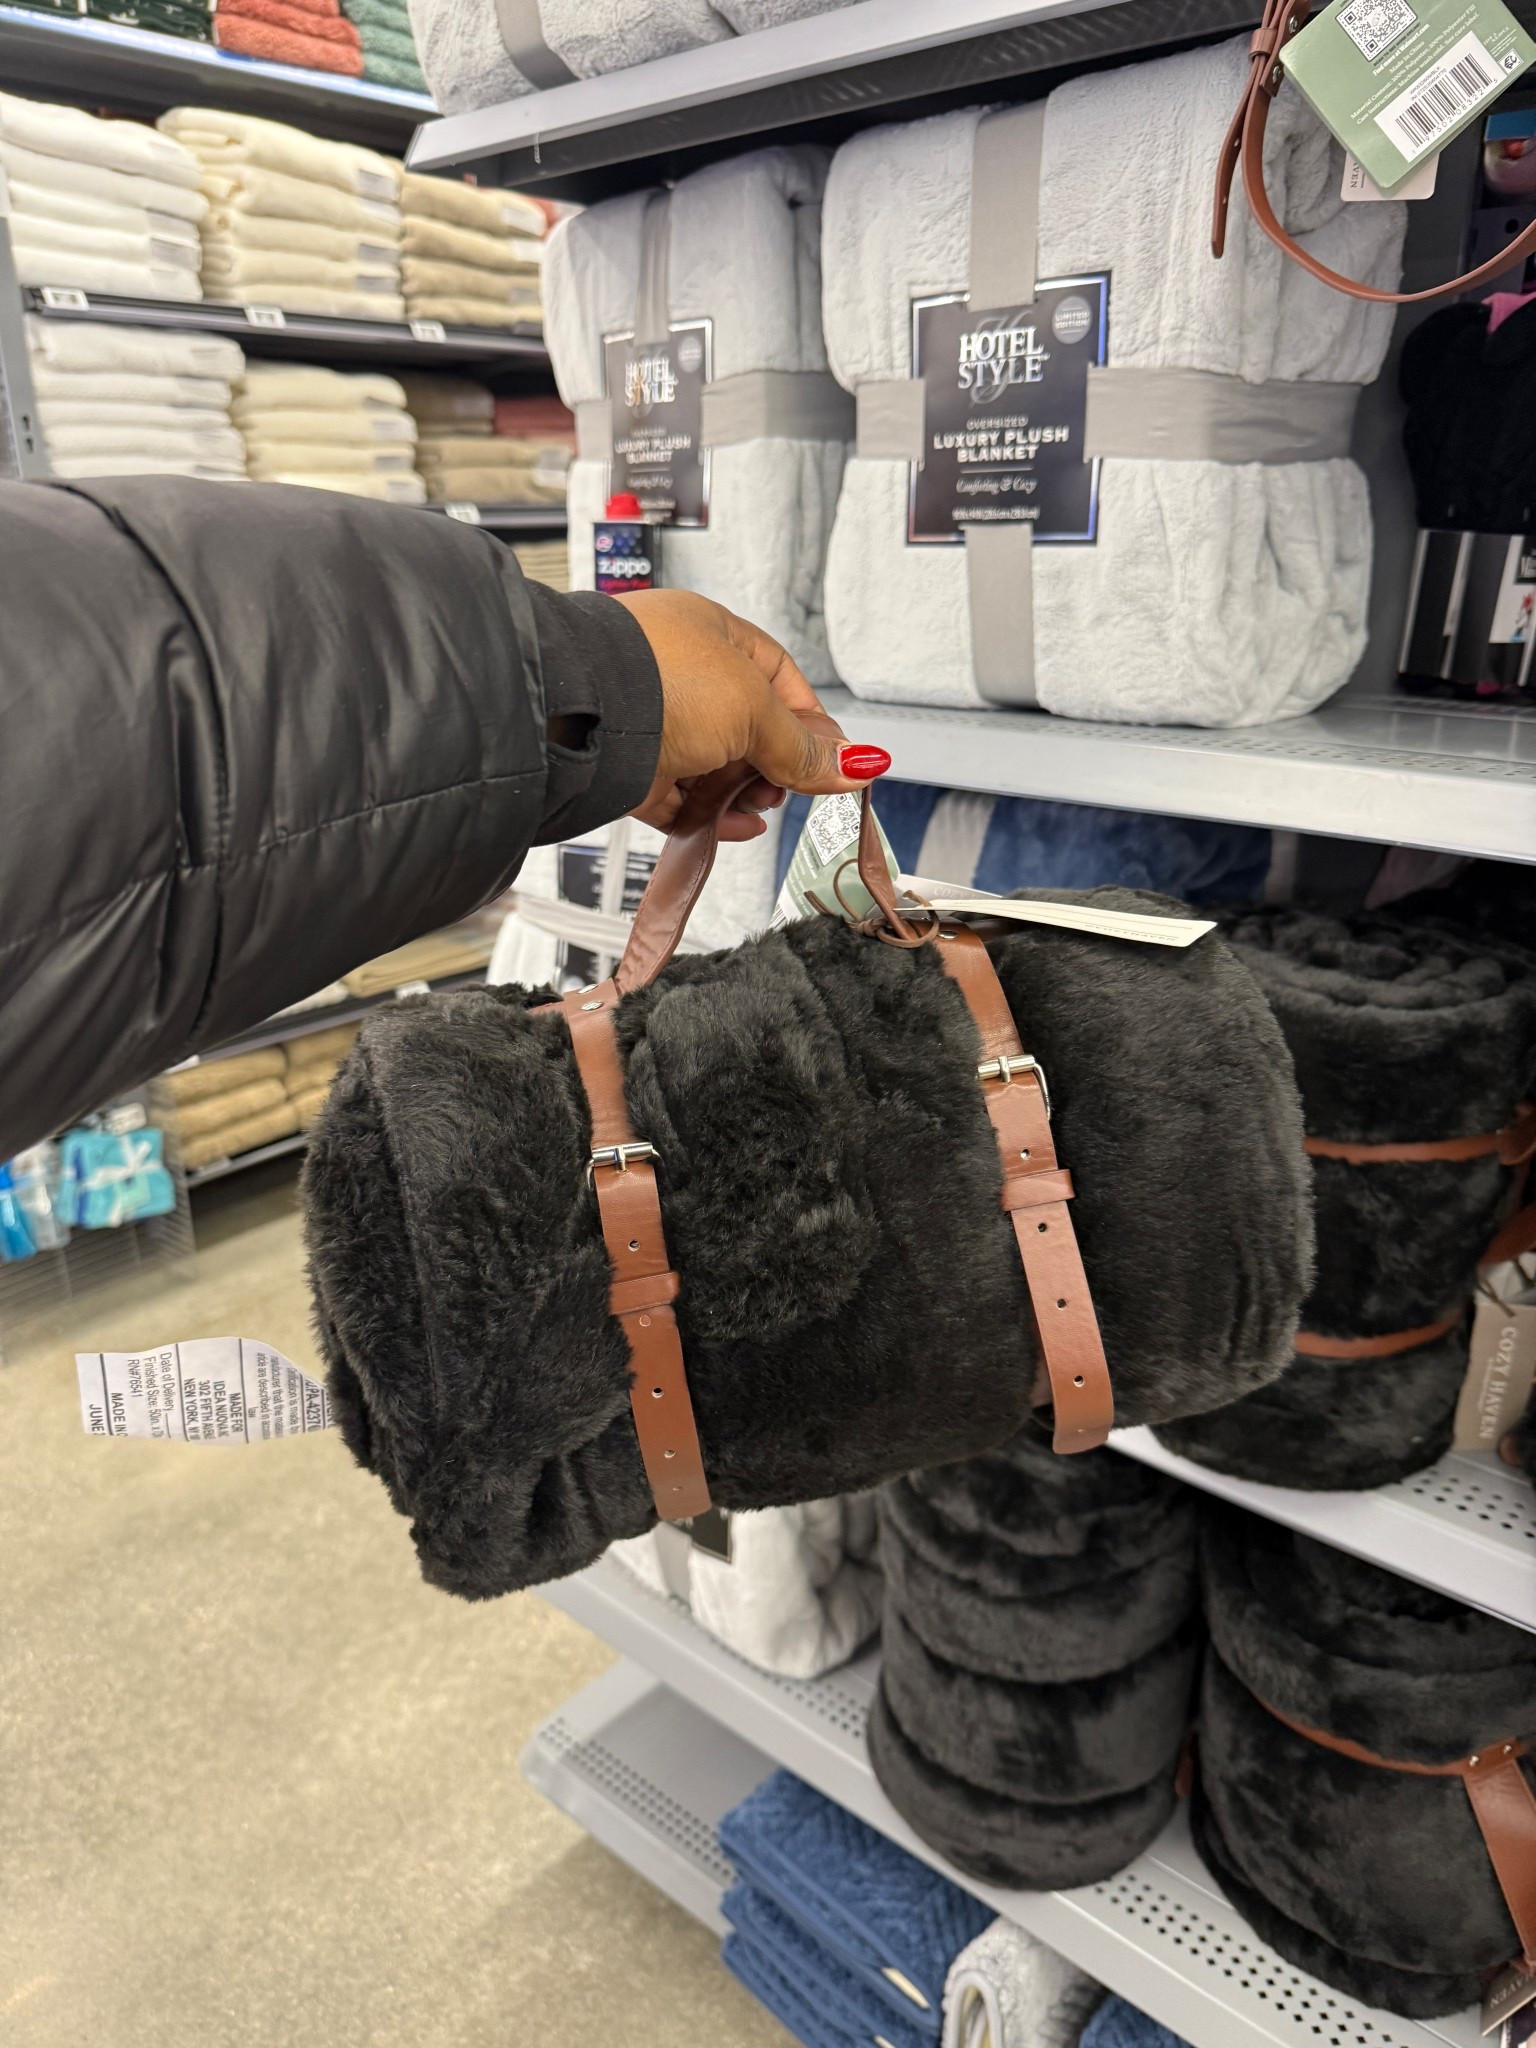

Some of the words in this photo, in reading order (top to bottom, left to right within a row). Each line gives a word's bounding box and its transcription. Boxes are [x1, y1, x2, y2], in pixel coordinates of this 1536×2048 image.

[1349, 98, 1372, 119] Material
[1370, 80, 1393, 101] Content:
[1391, 67, 1407, 82] 100%
[1428, 33, 1444, 49] 100%
[1442, 12, 1468, 36] Polyester
[1465, 3, 1476, 14] Fill
[1372, 64, 1384, 76] Find
[1382, 54, 1395, 67] more
[1398, 23, 1430, 52] Walmart.com
[1388, 58, 1404, 73] Made
[1402, 53, 1410, 61] in
[1408, 39, 1425, 56] China
[1356, 112, 1369, 124] Care
[1397, 67, 1419, 87] Machine
[1416, 54, 1433, 69] wash
[1443, 33, 1455, 45] See
[1453, 24, 1466, 36] care
[1424, 115, 1454, 142] 97502
[1454, 88, 1484, 115] 08322
[959, 328, 1044, 360] HOTEL
[626, 358, 675, 385] HOTEL
[958, 357, 1044, 389] STYLE
[624, 385, 675, 407] STYLE
[967, 417, 1028, 430] OVERSIZED
[933, 430, 1000, 450] LUXURY
[1005, 426, 1069, 446] PLUSH
[957, 445, 1039, 463] BLANKET
[598, 557, 651, 578] zippo
[159, 1352, 173, 1373] Date
[1495, 1327, 1517, 1375] COZY
[127, 1358, 142, 1397] RN#76541
[143, 1356, 158, 1389] Finished
[162, 1373, 174, 1382] of
[258, 1368, 266, 1378] are
[146, 1389, 160, 1408] Size:
[160, 1382, 177, 1411] Delivery
[182, 1378, 196, 1398] NEW
[198, 1379, 211, 1396] 302
[213, 1381, 226, 1403] IDEA
[259, 1379, 272, 1413] described
[273, 1388, 283, 1404] that
[88, 1403, 104, 1431] JUNE
[110, 1392, 125, 1422] MADE
[148, 1408, 162, 1425] 50in.
[183, 1399, 199, 1425] YORK,
[199, 1397, 213, 1421] FIFTH
[214, 1404, 229, 1431] NUOVA
[228, 1392, 242, 1418] MADE
[274, 1404, 283, 1417] the
[1479, 1380, 1507, 1439] HAVEN
[114, 1423, 126, 1432] IN
[231, 1419, 243, 1433] FOR
